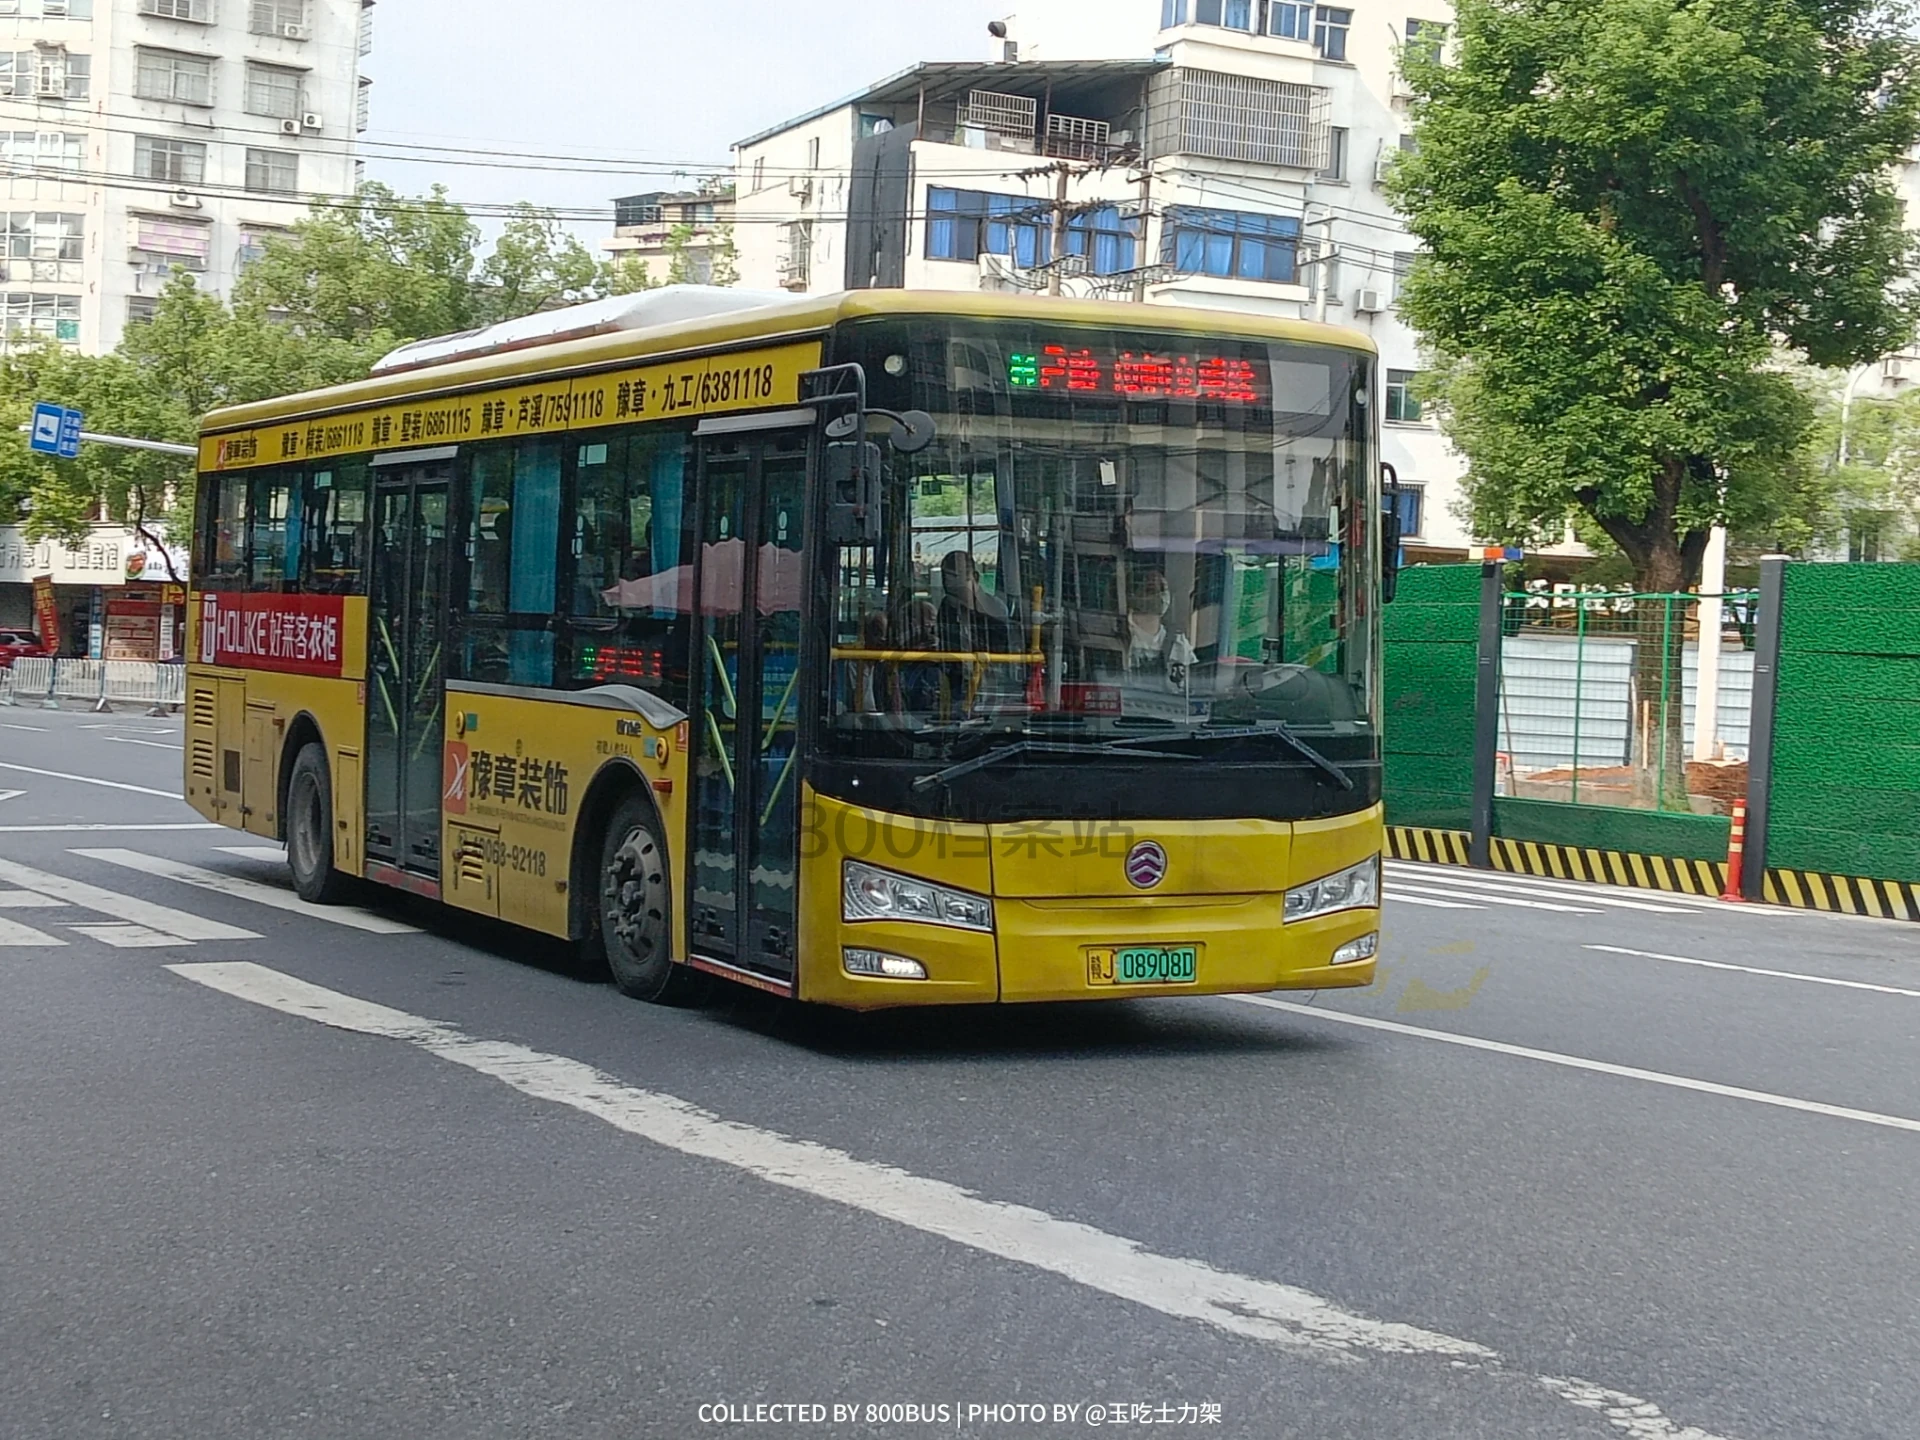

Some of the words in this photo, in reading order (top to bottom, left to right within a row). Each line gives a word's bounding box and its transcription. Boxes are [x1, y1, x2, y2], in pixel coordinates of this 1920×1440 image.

[616, 364, 773, 418] 豫章·九工/6381118
[269, 611, 337, 662] 好莱客衣柜
[469, 749, 569, 816] 豫章装饰
